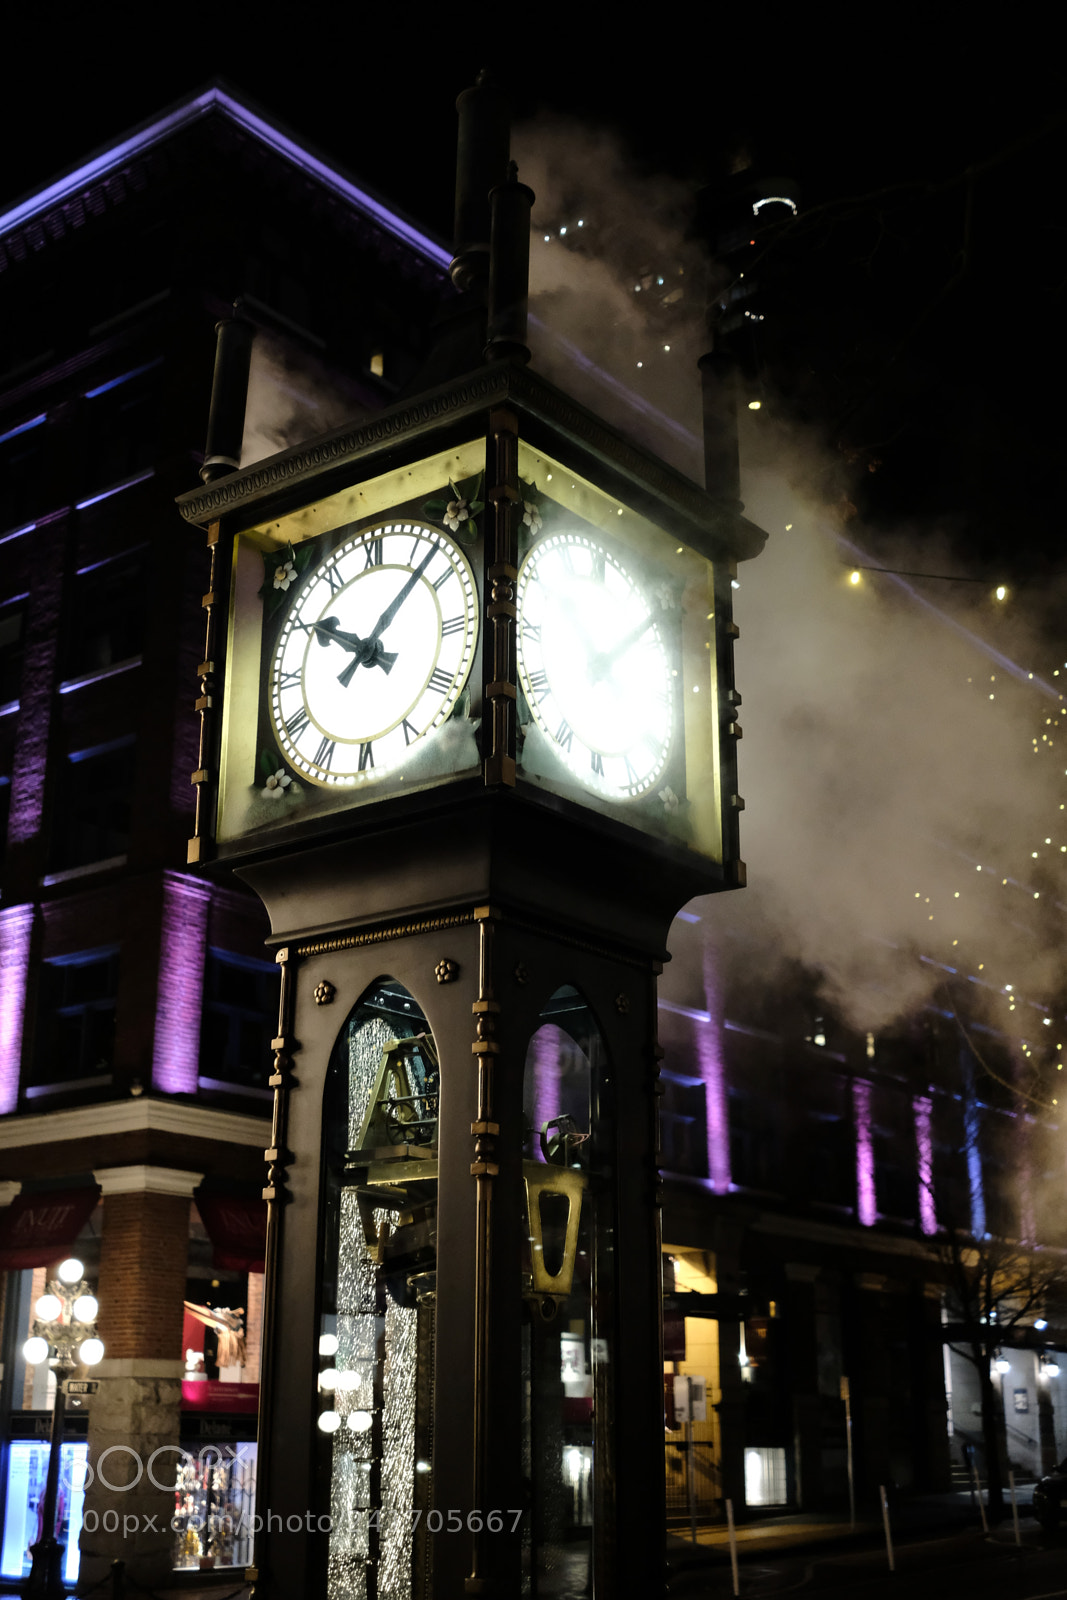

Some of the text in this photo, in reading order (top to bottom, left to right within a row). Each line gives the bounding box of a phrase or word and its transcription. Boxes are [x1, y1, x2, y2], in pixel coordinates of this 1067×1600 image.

[322, 565, 346, 597] XI
[432, 566, 455, 591] II
[441, 614, 465, 637] III
[280, 667, 302, 690] IX
[402, 718, 421, 745] V
[312, 738, 336, 771] VII
[358, 742, 375, 771] VI
